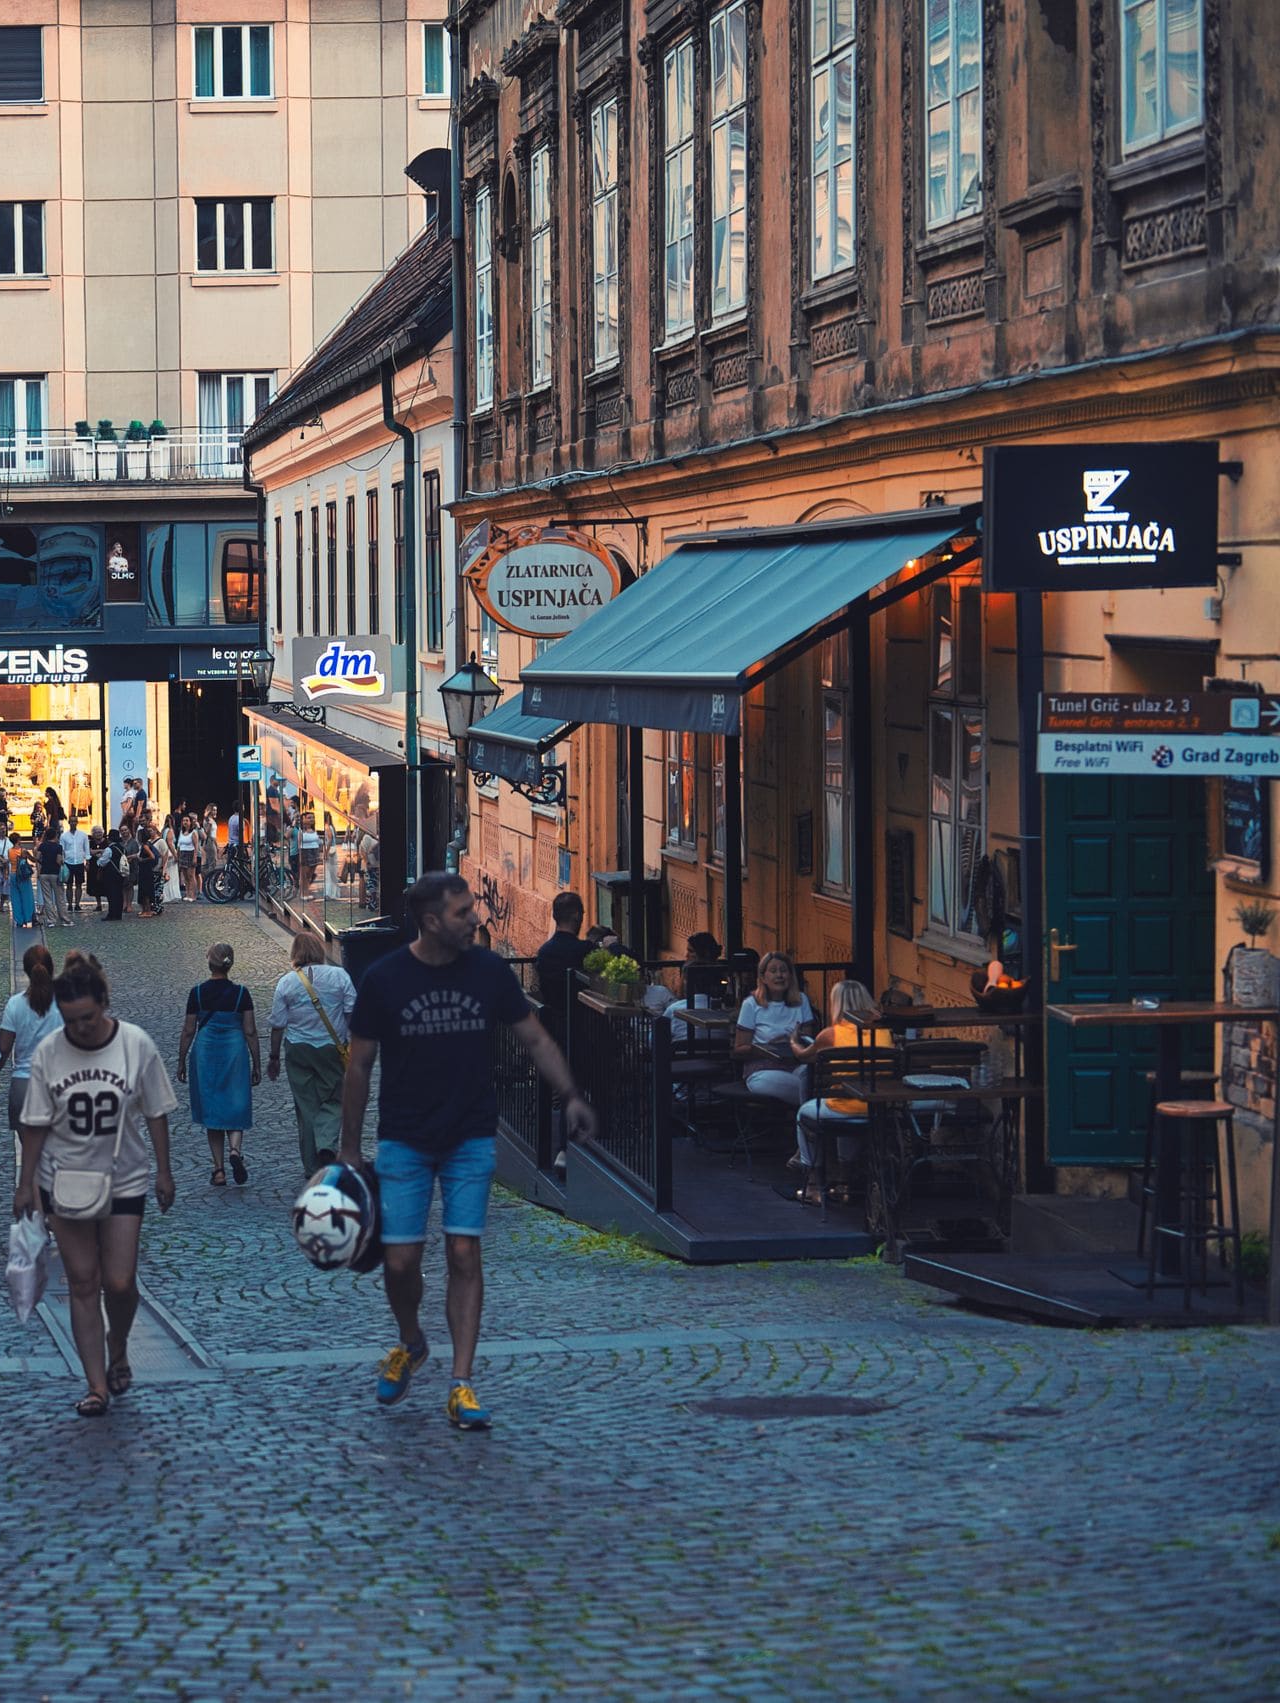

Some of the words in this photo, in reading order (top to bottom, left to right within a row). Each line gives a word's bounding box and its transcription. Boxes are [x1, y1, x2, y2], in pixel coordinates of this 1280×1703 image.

[1037, 521, 1176, 555] USPINJAČA
[506, 563, 593, 578] ZLATARNICA
[497, 583, 603, 608] USPINJAČA
[212, 647, 222, 659] le
[319, 646, 372, 677] dm
[7, 672, 88, 684] underwear
[1049, 697, 1087, 712] Tunel
[1091, 698, 1119, 712] Grič
[1133, 698, 1161, 712] ulaz
[1165, 699, 1177, 713] 2,
[1181, 699, 1190, 713] 3
[1048, 716, 1087, 728] Tunnel
[1124, 717, 1174, 728] entrance
[1191, 717, 1200, 728] 3
[113, 726, 142, 736] follow
[122, 741, 133, 749] us
[1054, 740, 1112, 754] Besplatni
[1116, 741, 1144, 752] WiFi
[1054, 757, 1081, 768] Free
[1084, 757, 1110, 768] WiFi
[1182, 748, 1220, 763] Grad
[1224, 748, 1279, 766] Zagreb
[401, 990, 481, 1020] ORIGINAL
[421, 1007, 462, 1022] GANT
[401, 1019, 485, 1036] SPORTSWEAR
[67, 1090, 120, 1136] 92
